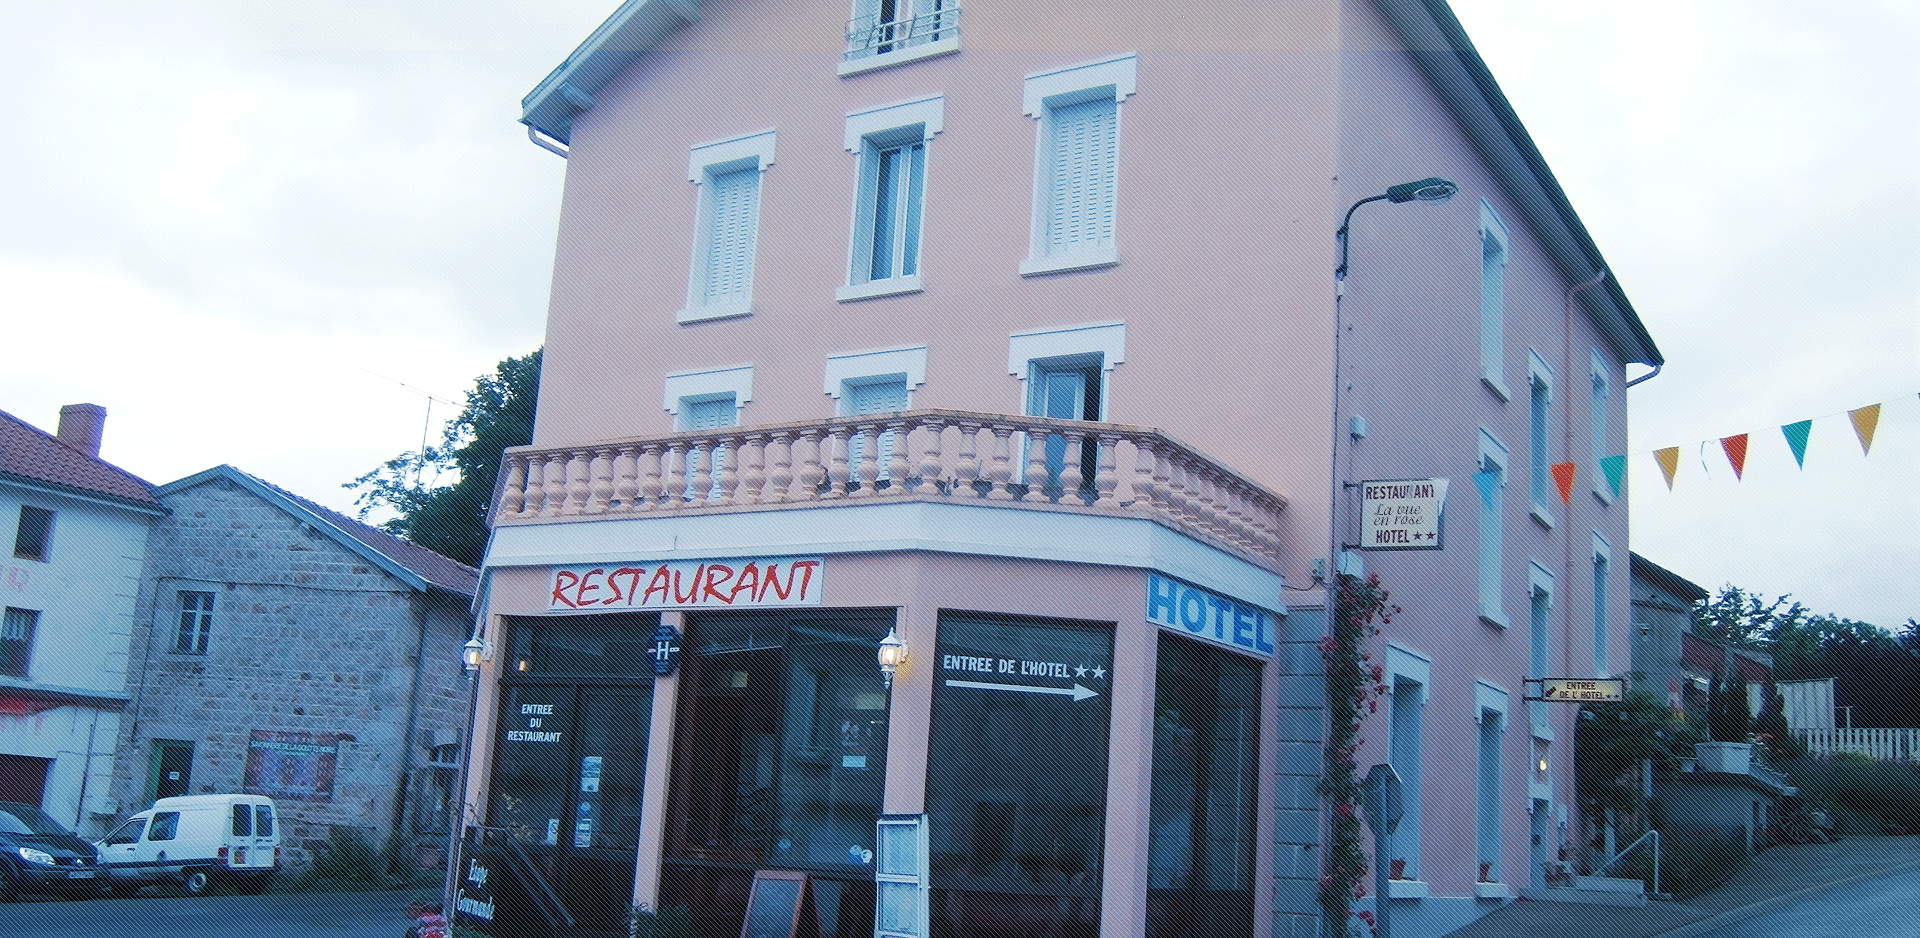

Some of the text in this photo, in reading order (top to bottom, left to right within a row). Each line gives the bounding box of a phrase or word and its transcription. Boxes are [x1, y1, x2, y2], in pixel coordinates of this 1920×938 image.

[1365, 484, 1434, 500] RESTAUANT
[1374, 503, 1422, 516] La vue
[1374, 515, 1424, 526] en rose
[1376, 529, 1410, 544] HOTEL
[552, 561, 820, 609] RESTAURANT
[1148, 574, 1274, 655] HOTEL
[656, 641, 669, 660] H
[943, 654, 1070, 678] ENTREE DE L'HOTEL
[1566, 681, 1596, 690] ENTREE
[1559, 691, 1569, 699] DE
[1580, 691, 1605, 699] HOTEL
[521, 703, 554, 715] ENTREE
[530, 717, 542, 728] DU
[507, 730, 562, 743] RESTAURANT
